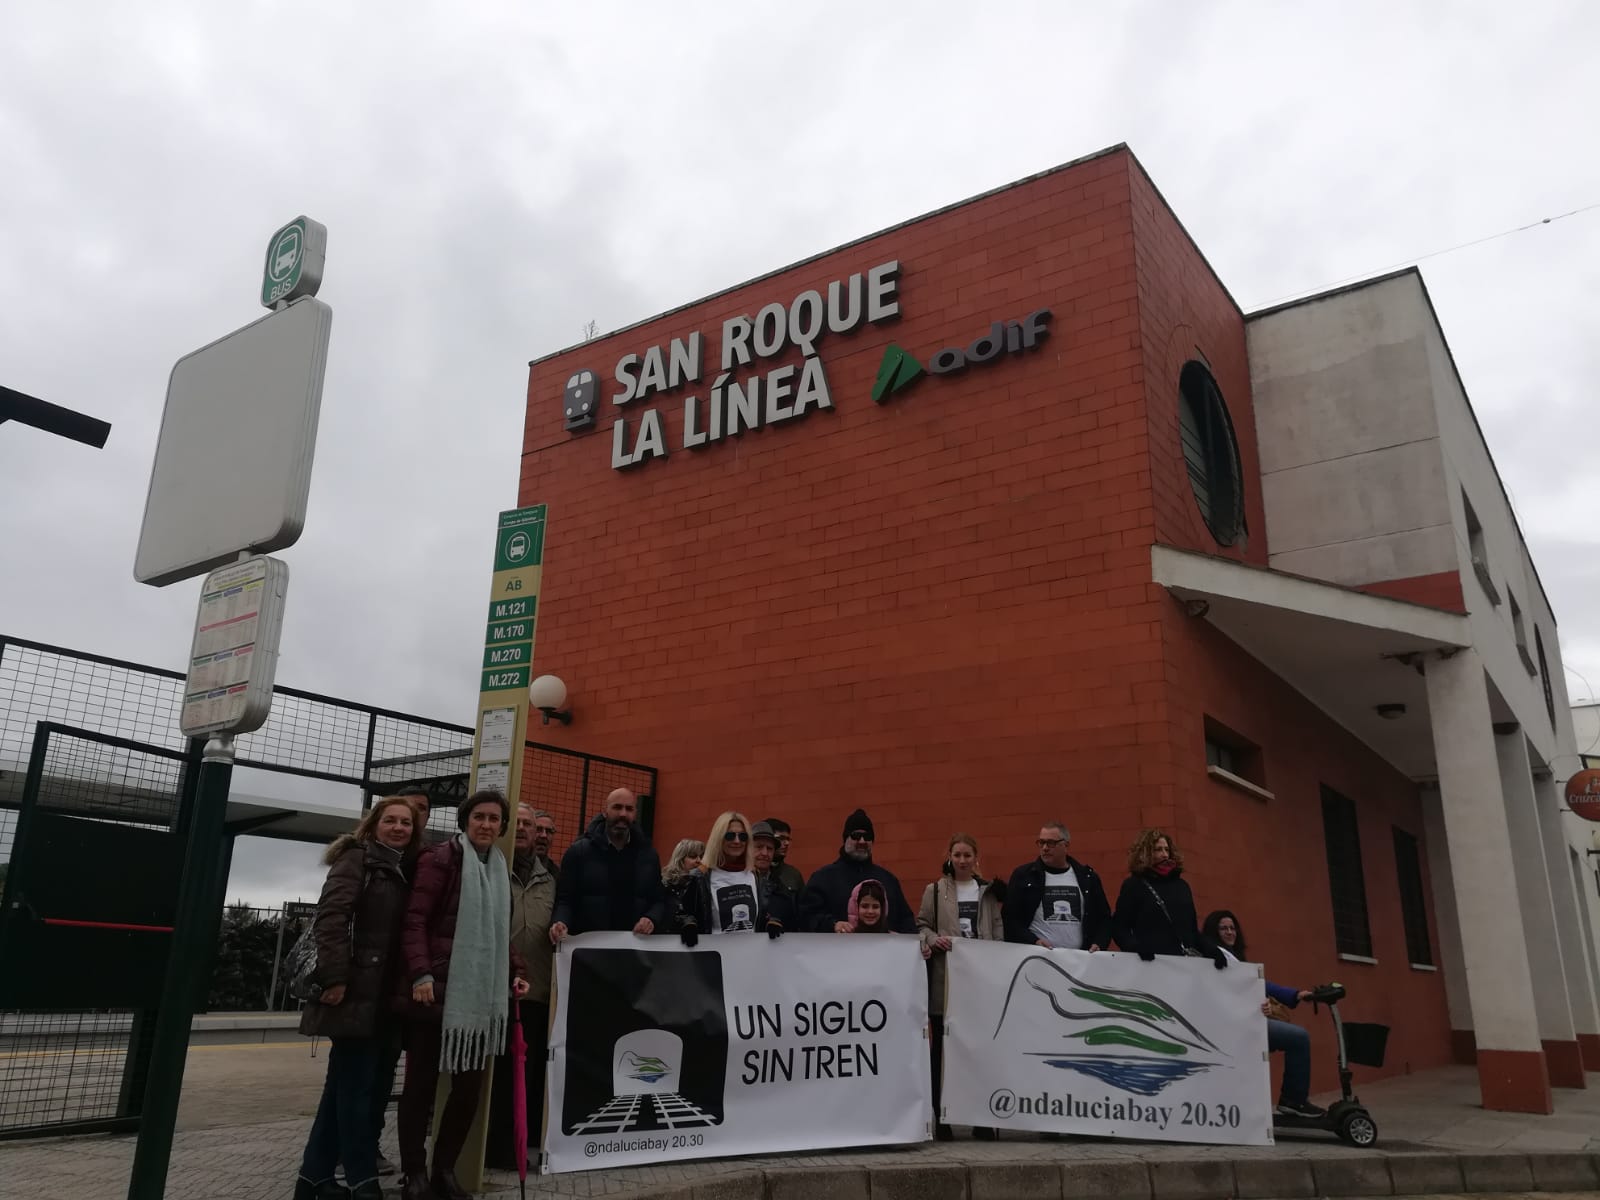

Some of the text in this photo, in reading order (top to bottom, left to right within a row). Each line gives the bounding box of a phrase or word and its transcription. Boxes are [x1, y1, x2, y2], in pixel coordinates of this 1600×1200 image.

[270, 278, 292, 300] BUS
[613, 259, 901, 406] SAN ROQUE
[929, 307, 1054, 374] adif
[611, 355, 835, 471] LA LÍNEA
[505, 579, 522, 592] AB
[496, 602, 526, 617] M.121
[493, 624, 524, 639] M.170
[491, 647, 521, 663] M.270
[488, 671, 520, 687] M.272
[734, 999, 888, 1041] UN SIGLO
[741, 1043, 879, 1086] SIN TREN
[989, 1088, 1241, 1130] @ndaluciabay 20.30
[584, 1133, 704, 1157] @ndaluciabay 20.30
